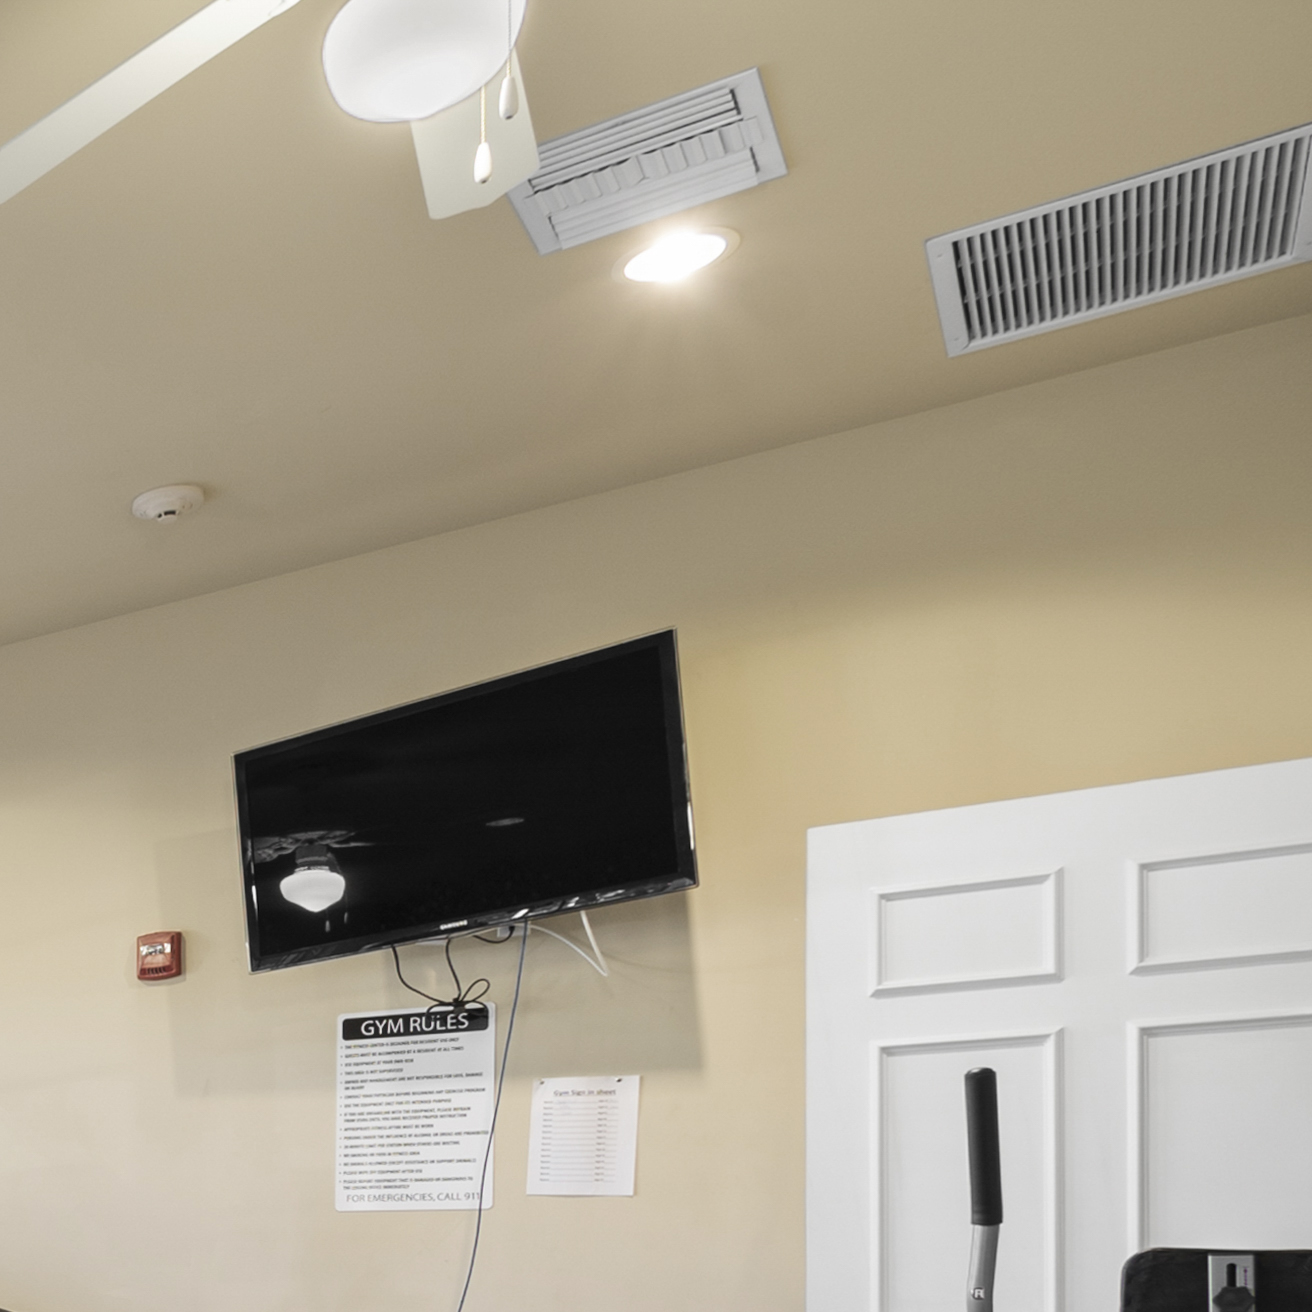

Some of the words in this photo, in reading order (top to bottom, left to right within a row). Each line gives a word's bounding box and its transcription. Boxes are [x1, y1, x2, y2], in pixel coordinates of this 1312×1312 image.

[361, 1018, 404, 1036] GYM
[409, 1012, 469, 1033] RULES
[346, 1194, 365, 1203] FOR
[367, 1193, 436, 1203] EMERGENCIES,
[437, 1192, 461, 1201] CALL
[464, 1192, 480, 1201] 911
